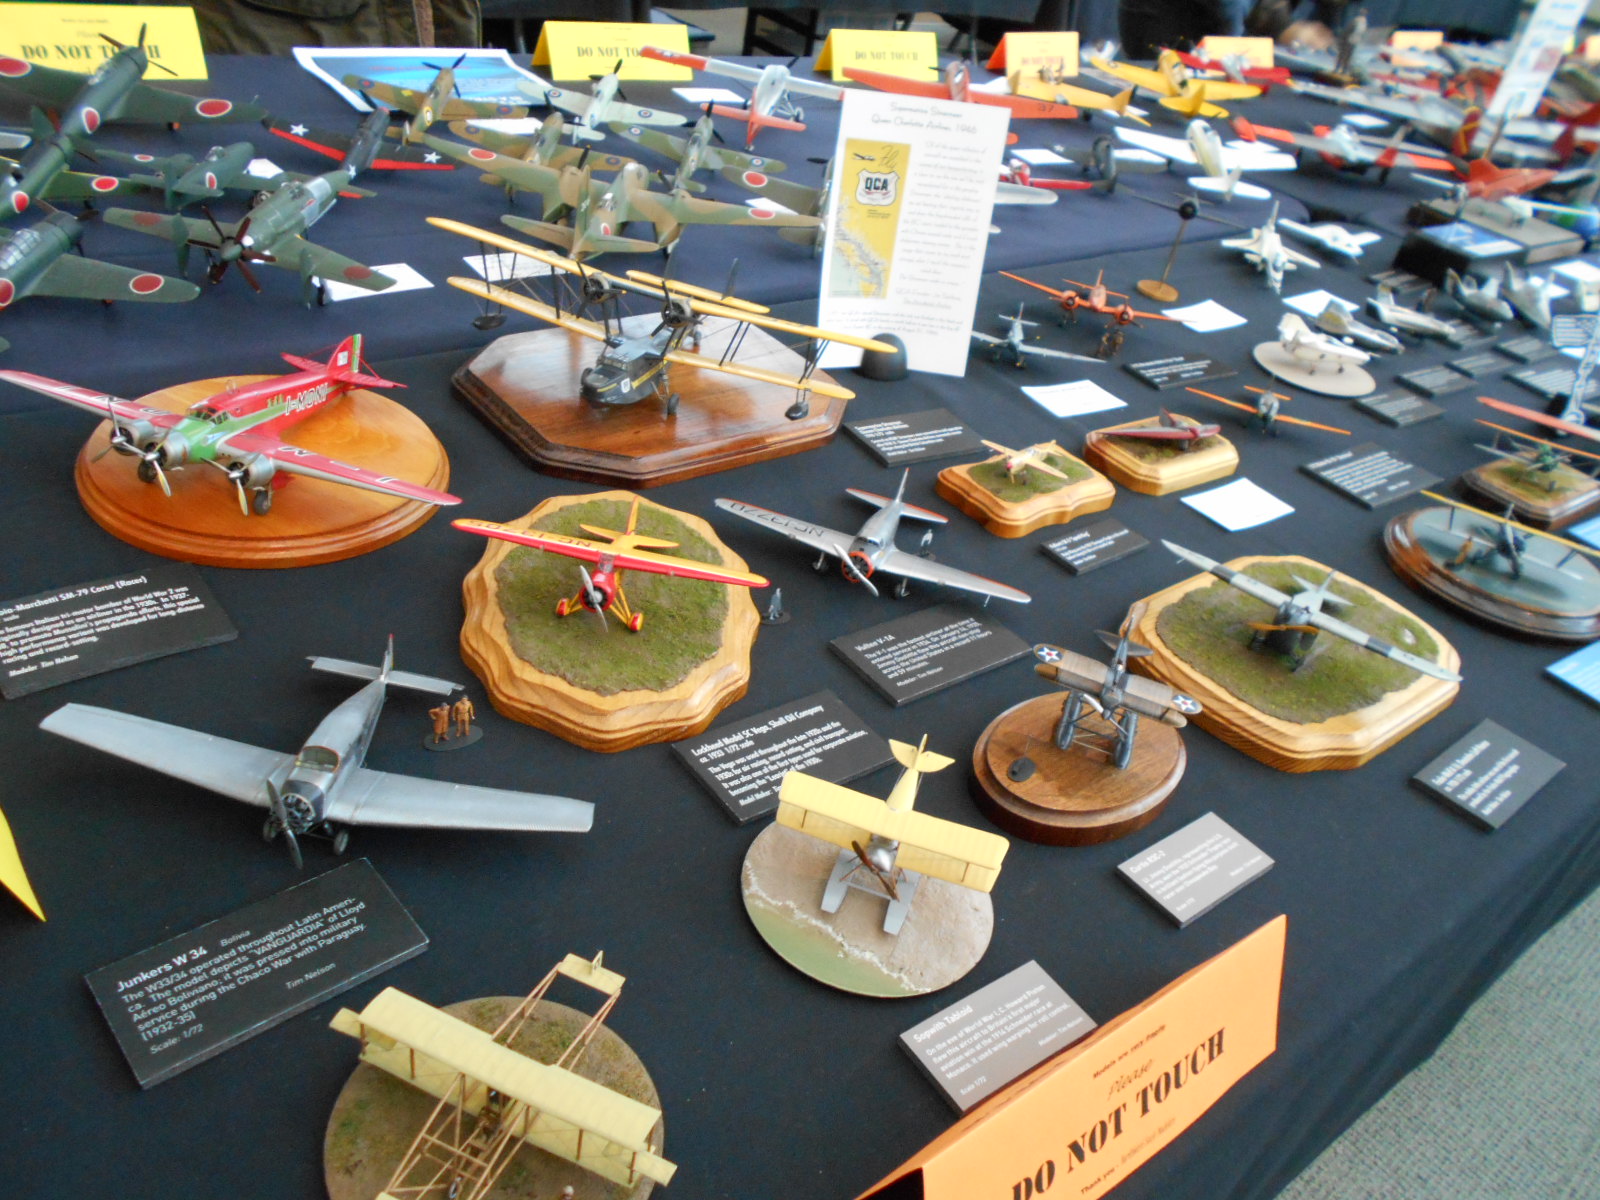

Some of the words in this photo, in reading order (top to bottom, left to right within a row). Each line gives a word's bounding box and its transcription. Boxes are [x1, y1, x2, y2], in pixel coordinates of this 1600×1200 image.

[20, 45, 48, 58] DO
[54, 45, 92, 58] NOT
[577, 46, 593, 57] DO
[598, 46, 620, 57] NOT
[864, 176, 888, 191] QCA
[59, 588, 88, 600] SM-79
[90, 584, 114, 593] Corsa
[94, 601, 121, 610] bomber
[131, 593, 153, 601] World
[876, 634, 895, 643] V-1A
[28, 648, 44, 656] and
[691, 739, 724, 755] Lockheed
[722, 732, 743, 744] Model
[750, 725, 771, 734] Vega,
[768, 717, 786, 727] Shell
[784, 713, 796, 721] Oil
[794, 705, 823, 718] Company
[118, 963, 172, 991] Junkers
[172, 954, 186, 965] W
[189, 946, 207, 959] 34
[220, 930, 250, 946] Bolivia
[121, 990, 144, 1002] The
[145, 971, 187, 992] W33/34
[189, 948, 236, 974] operated
[237, 923, 293, 952] throughout
[294, 912, 321, 926] Latin
[323, 898, 355, 914] Ameri-
[127, 1003, 144, 1012] ca.
[149, 989, 171, 1001] The
[173, 972, 208, 991] model
[210, 955, 248, 975] depicts
[327, 913, 337, 922] of
[338, 901, 365, 917] Lloyd
[223, 972, 231, 980] it
[232, 963, 254, 975] was
[256, 942, 297, 966] pressed
[298, 934, 318, 946] into
[319, 916, 356, 936] military
[137, 1009, 177, 1030] service
[179, 991, 216, 1014] during
[217, 983, 235, 993] the
[236, 966, 270, 984] Chaco
[271, 955, 291, 968] War
[294, 945, 317, 958] with
[285, 978, 303, 988] Tim
[304, 963, 335, 980] Nelson
[141, 1010, 195, 1040] (1932-35)
[182, 1023, 202, 1037] 1/72
[913, 1021, 946, 1042] Sopwith
[943, 1005, 972, 1023] Tabloid
[963, 1019, 982, 1033] World
[981, 1013, 994, 1022] War
[1107, 1058, 1154, 1101] Please
[1012, 1160, 1056, 1200] DO
[1067, 1103, 1127, 1174] NOT
[1136, 1026, 1226, 1118] TOUCH
[1080, 1178, 1102, 1195] Thank
